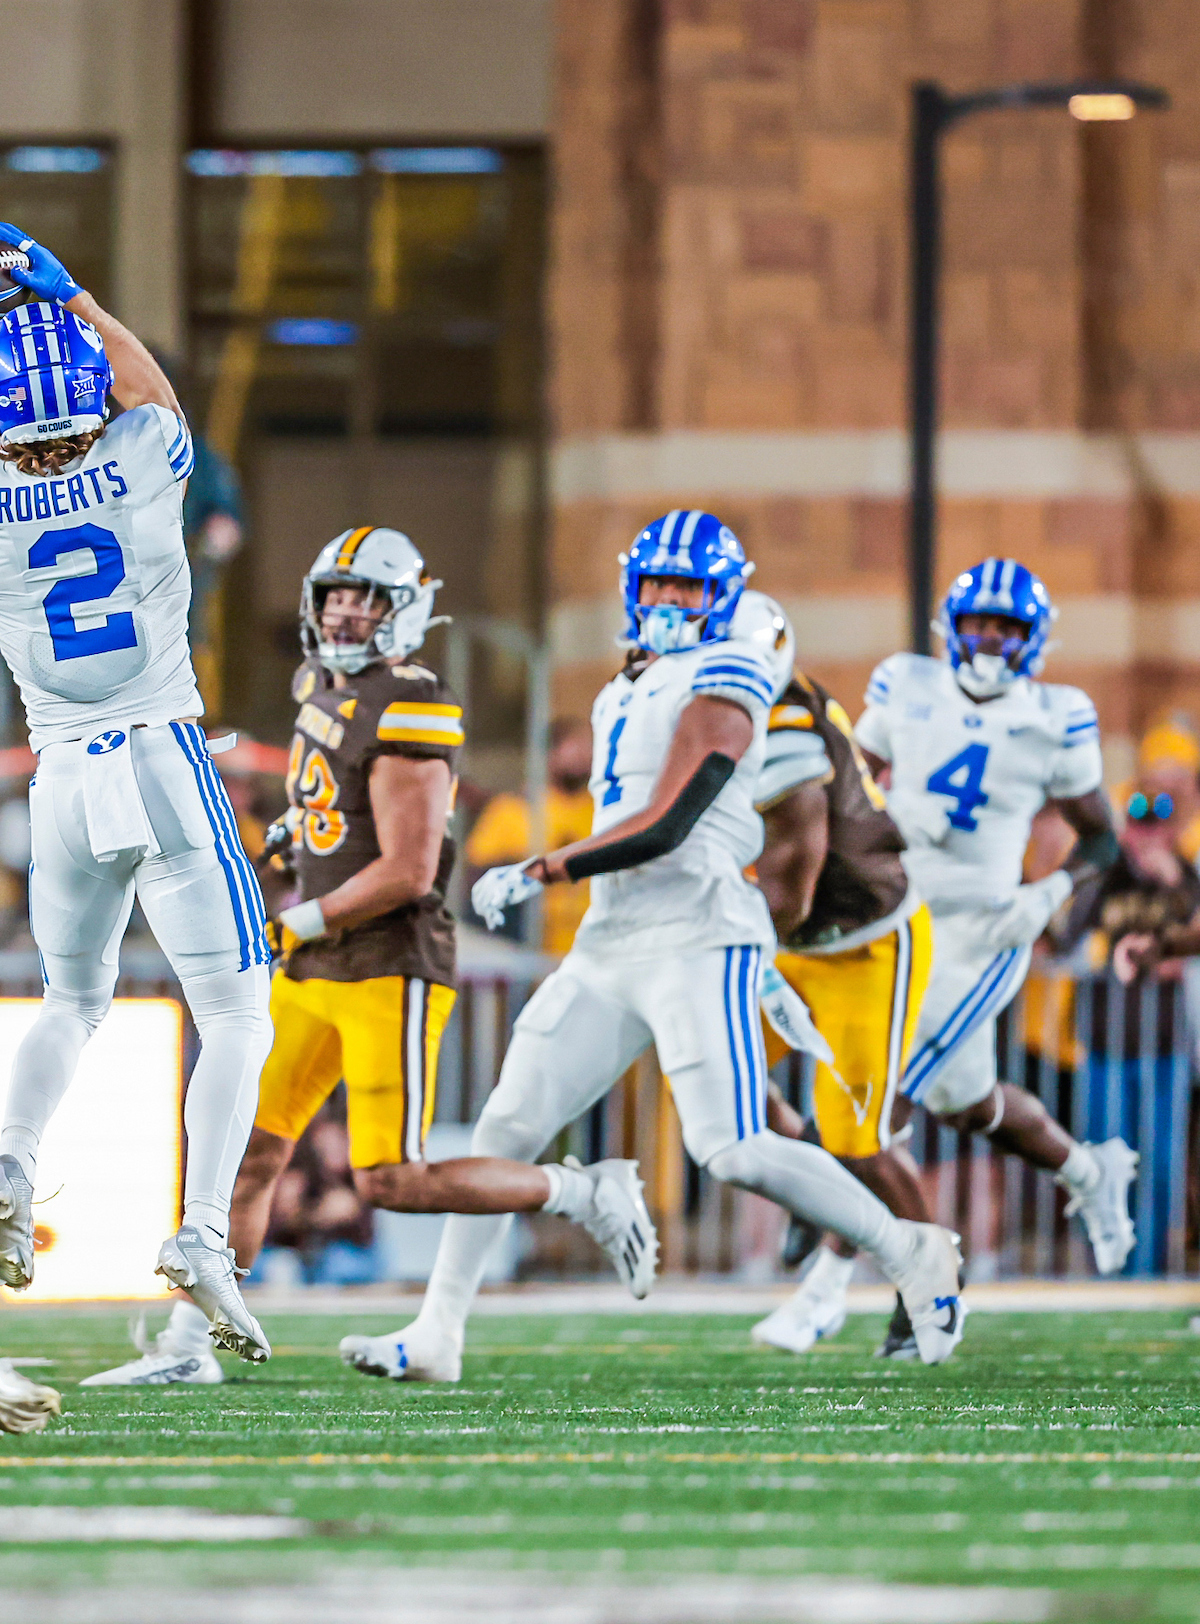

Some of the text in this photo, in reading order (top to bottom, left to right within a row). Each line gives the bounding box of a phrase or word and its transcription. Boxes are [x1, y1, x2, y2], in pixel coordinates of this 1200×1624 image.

[14, 400, 24, 411] 2
[37, 420, 72, 434] GO COUGS
[28, 522, 138, 662] 2
[90, 731, 123, 753] Y
[602, 716, 627, 807] 1
[927, 742, 991, 832] 4
[178, 1234, 198, 1243] NIKE
